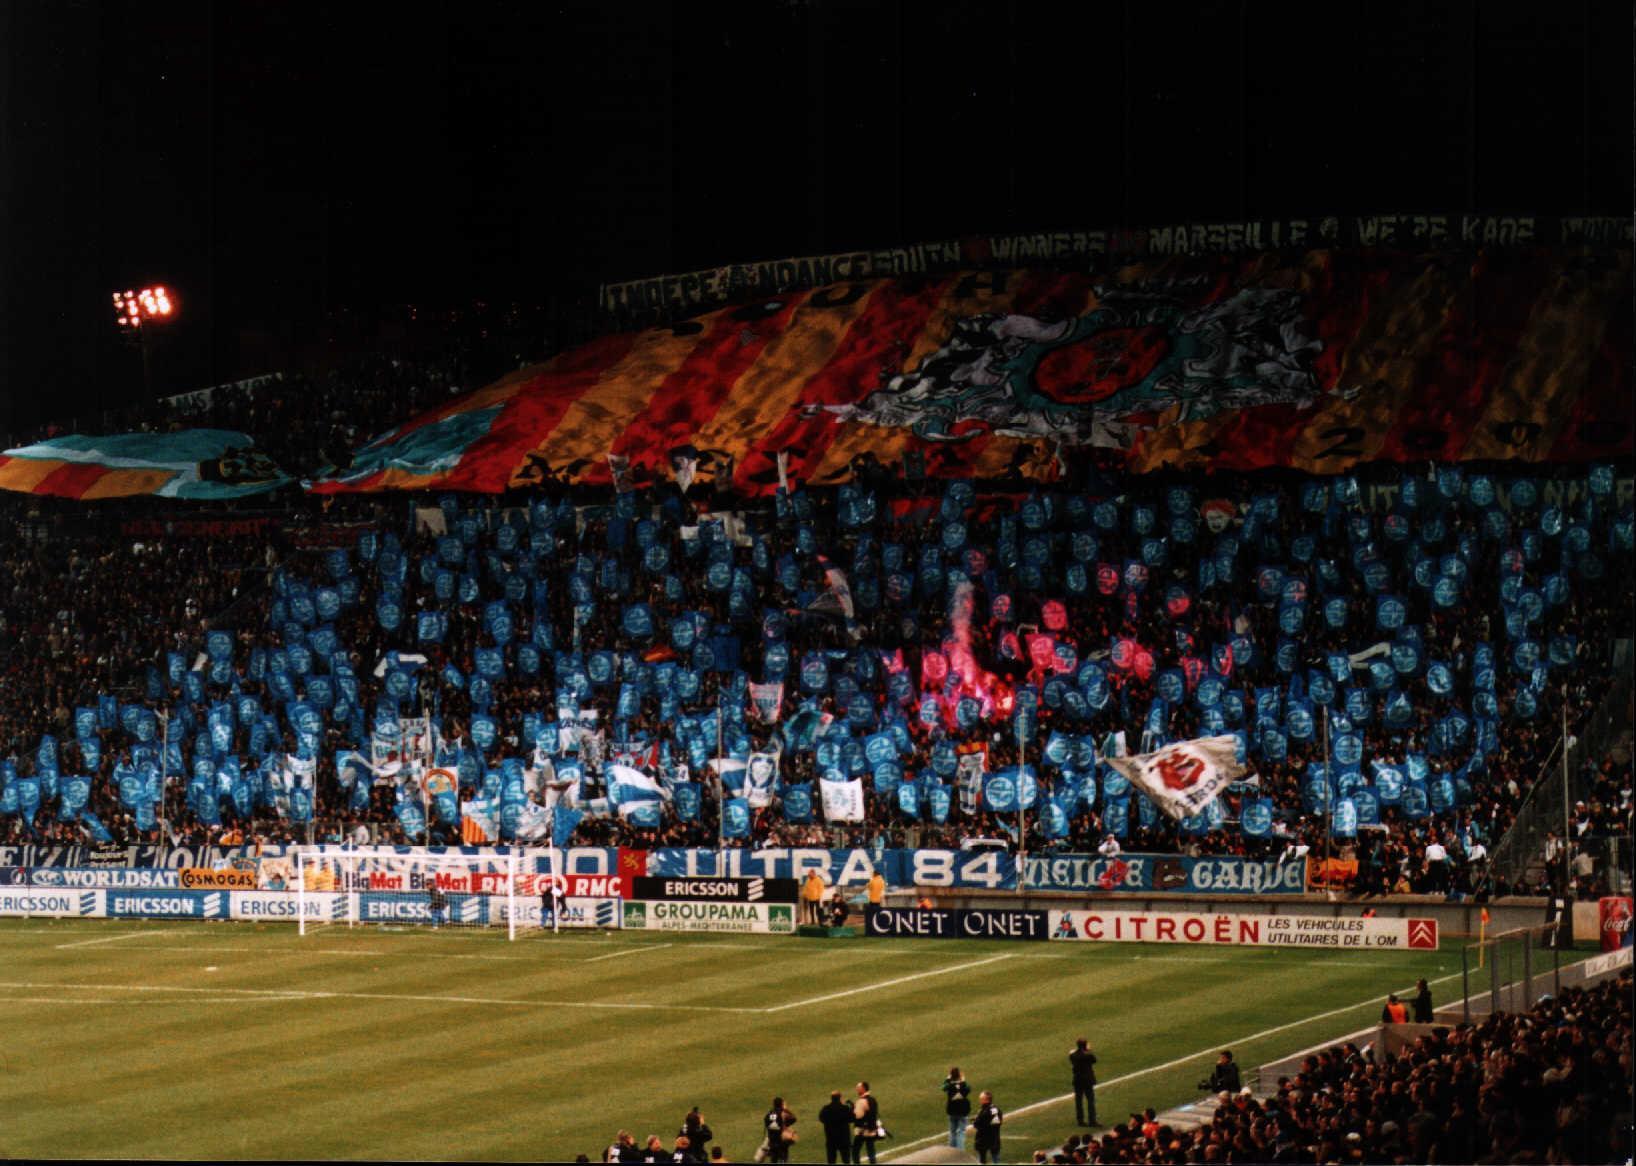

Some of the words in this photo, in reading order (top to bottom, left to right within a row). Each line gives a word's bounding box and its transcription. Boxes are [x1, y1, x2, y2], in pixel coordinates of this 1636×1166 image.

[687, 848, 875, 886] ULTRA
[62, 869, 178, 888] WORLDSAT
[181, 868, 254, 887] COSMOGAS
[1191, 861, 1301, 893] GARDE
[575, 877, 623, 897] RMC
[665, 881, 739, 896] ERICSSON
[115, 897, 194, 914] ERICSSON
[654, 902, 759, 920] GROUPAMA
[872, 910, 949, 934] ONET
[963, 911, 1041, 936] ONET
[1083, 915, 1259, 944] CITROËN
[1267, 919, 1291, 929] LES
[1267, 933, 1339, 946] UTILITAIRES
[1343, 935, 1361, 946] DE
